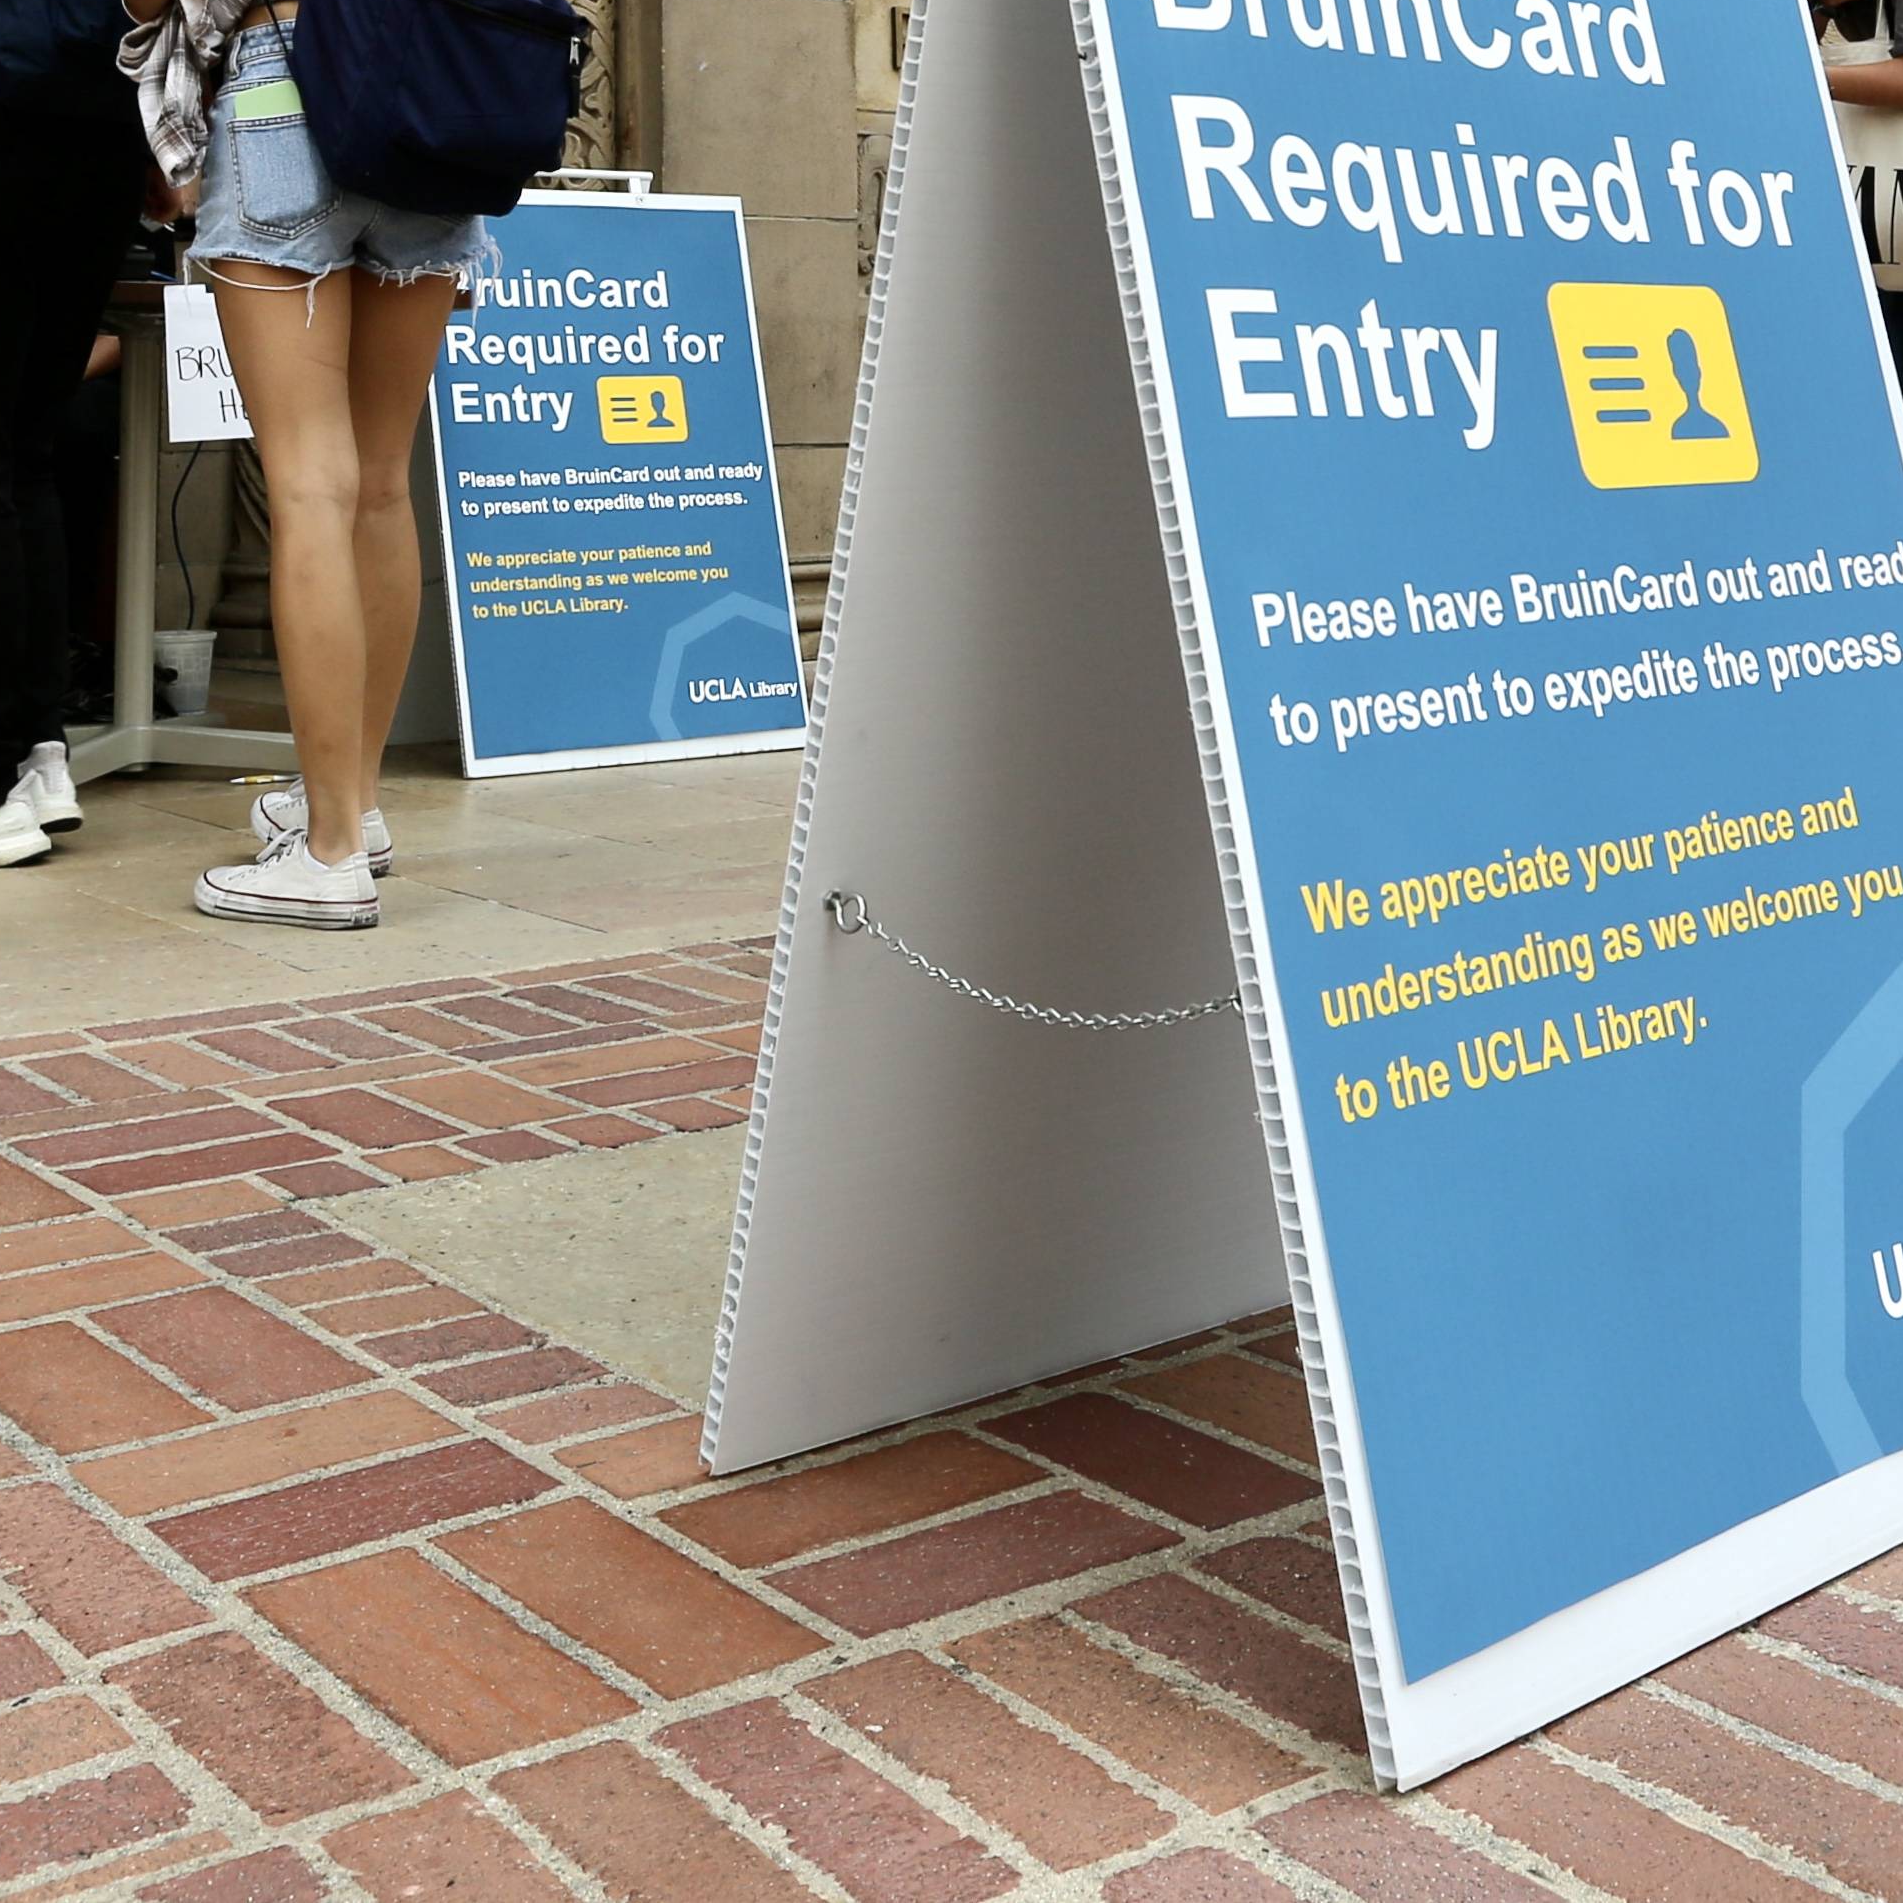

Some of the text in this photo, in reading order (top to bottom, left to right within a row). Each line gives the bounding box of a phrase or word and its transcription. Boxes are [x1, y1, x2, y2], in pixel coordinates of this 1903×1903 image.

[1171, 95, 1793, 262] Required for
[459, 269, 668, 308] ruinCard
[446, 325, 724, 373] Required for
[1206, 289, 1497, 449] Entry
[452, 384, 572, 431] Entry
[459, 463, 762, 487] Please have BruinCard out and ready
[461, 493, 747, 518] to present to expedite the process.
[467, 542, 711, 569] We appreciate your patience and
[471, 568, 728, 592] understanding as we welcome you
[1252, 592, 1396, 646] Please
[1404, 584, 1503, 633] have
[1511, 561, 1698, 622] BruinCard
[1707, 558, 1759, 603] out
[1768, 549, 1832, 597] and
[473, 598, 628, 618] to the UCLA Library.
[690, 678, 797, 702] UCLA Library
[1270, 694, 1318, 745] to
[1331, 673, 1487, 752] present
[1493, 670, 1534, 717] to
[1545, 650, 1698, 717] expedite
[1704, 643, 1759, 689] the
[1301, 787, 1858, 933] We appreciate your patience and
[1322, 866, 1903, 1027] understanding as we welcome you
[1335, 997, 1707, 1122] to the UCLA Library.
